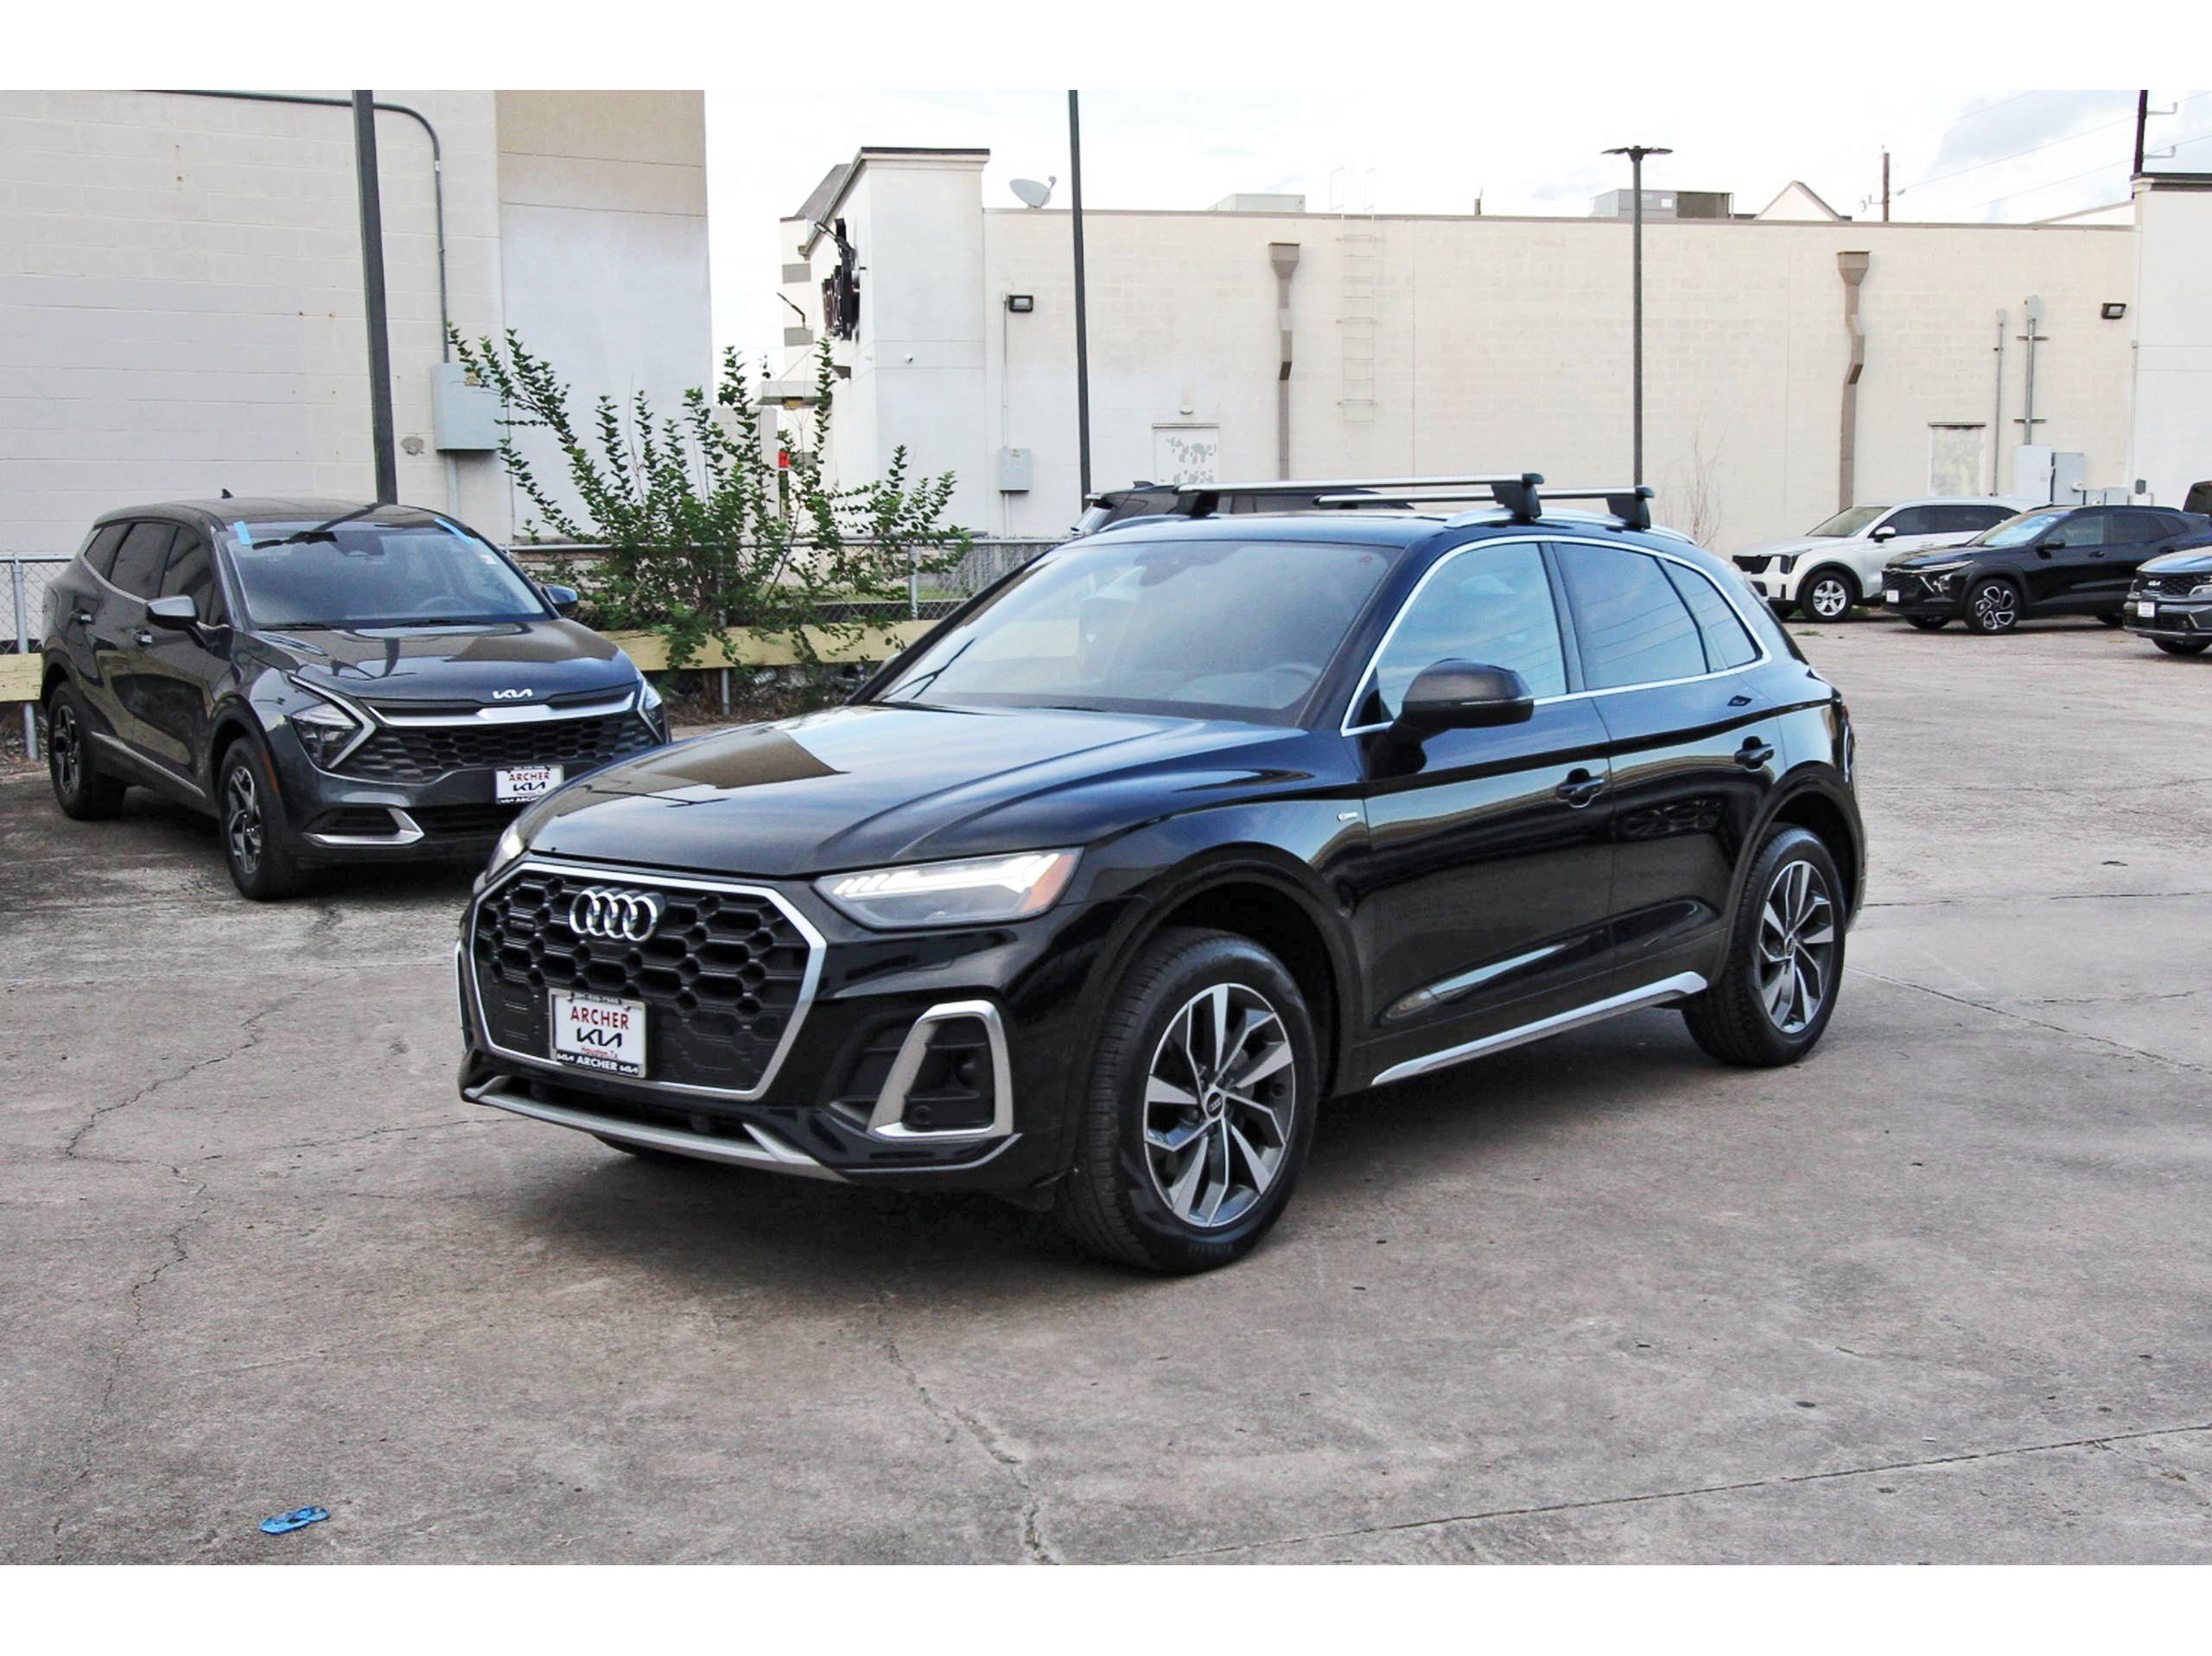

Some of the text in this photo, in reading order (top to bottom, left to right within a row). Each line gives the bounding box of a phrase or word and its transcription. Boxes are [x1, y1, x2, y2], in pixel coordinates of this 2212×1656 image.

[493, 688, 533, 699] KIA
[509, 772, 550, 781] ARCHER
[513, 781, 546, 792] KIA
[571, 1006, 630, 1029] ARCHER
[576, 1028, 622, 1048] KIA
[576, 1055, 618, 1071] ARCHER
